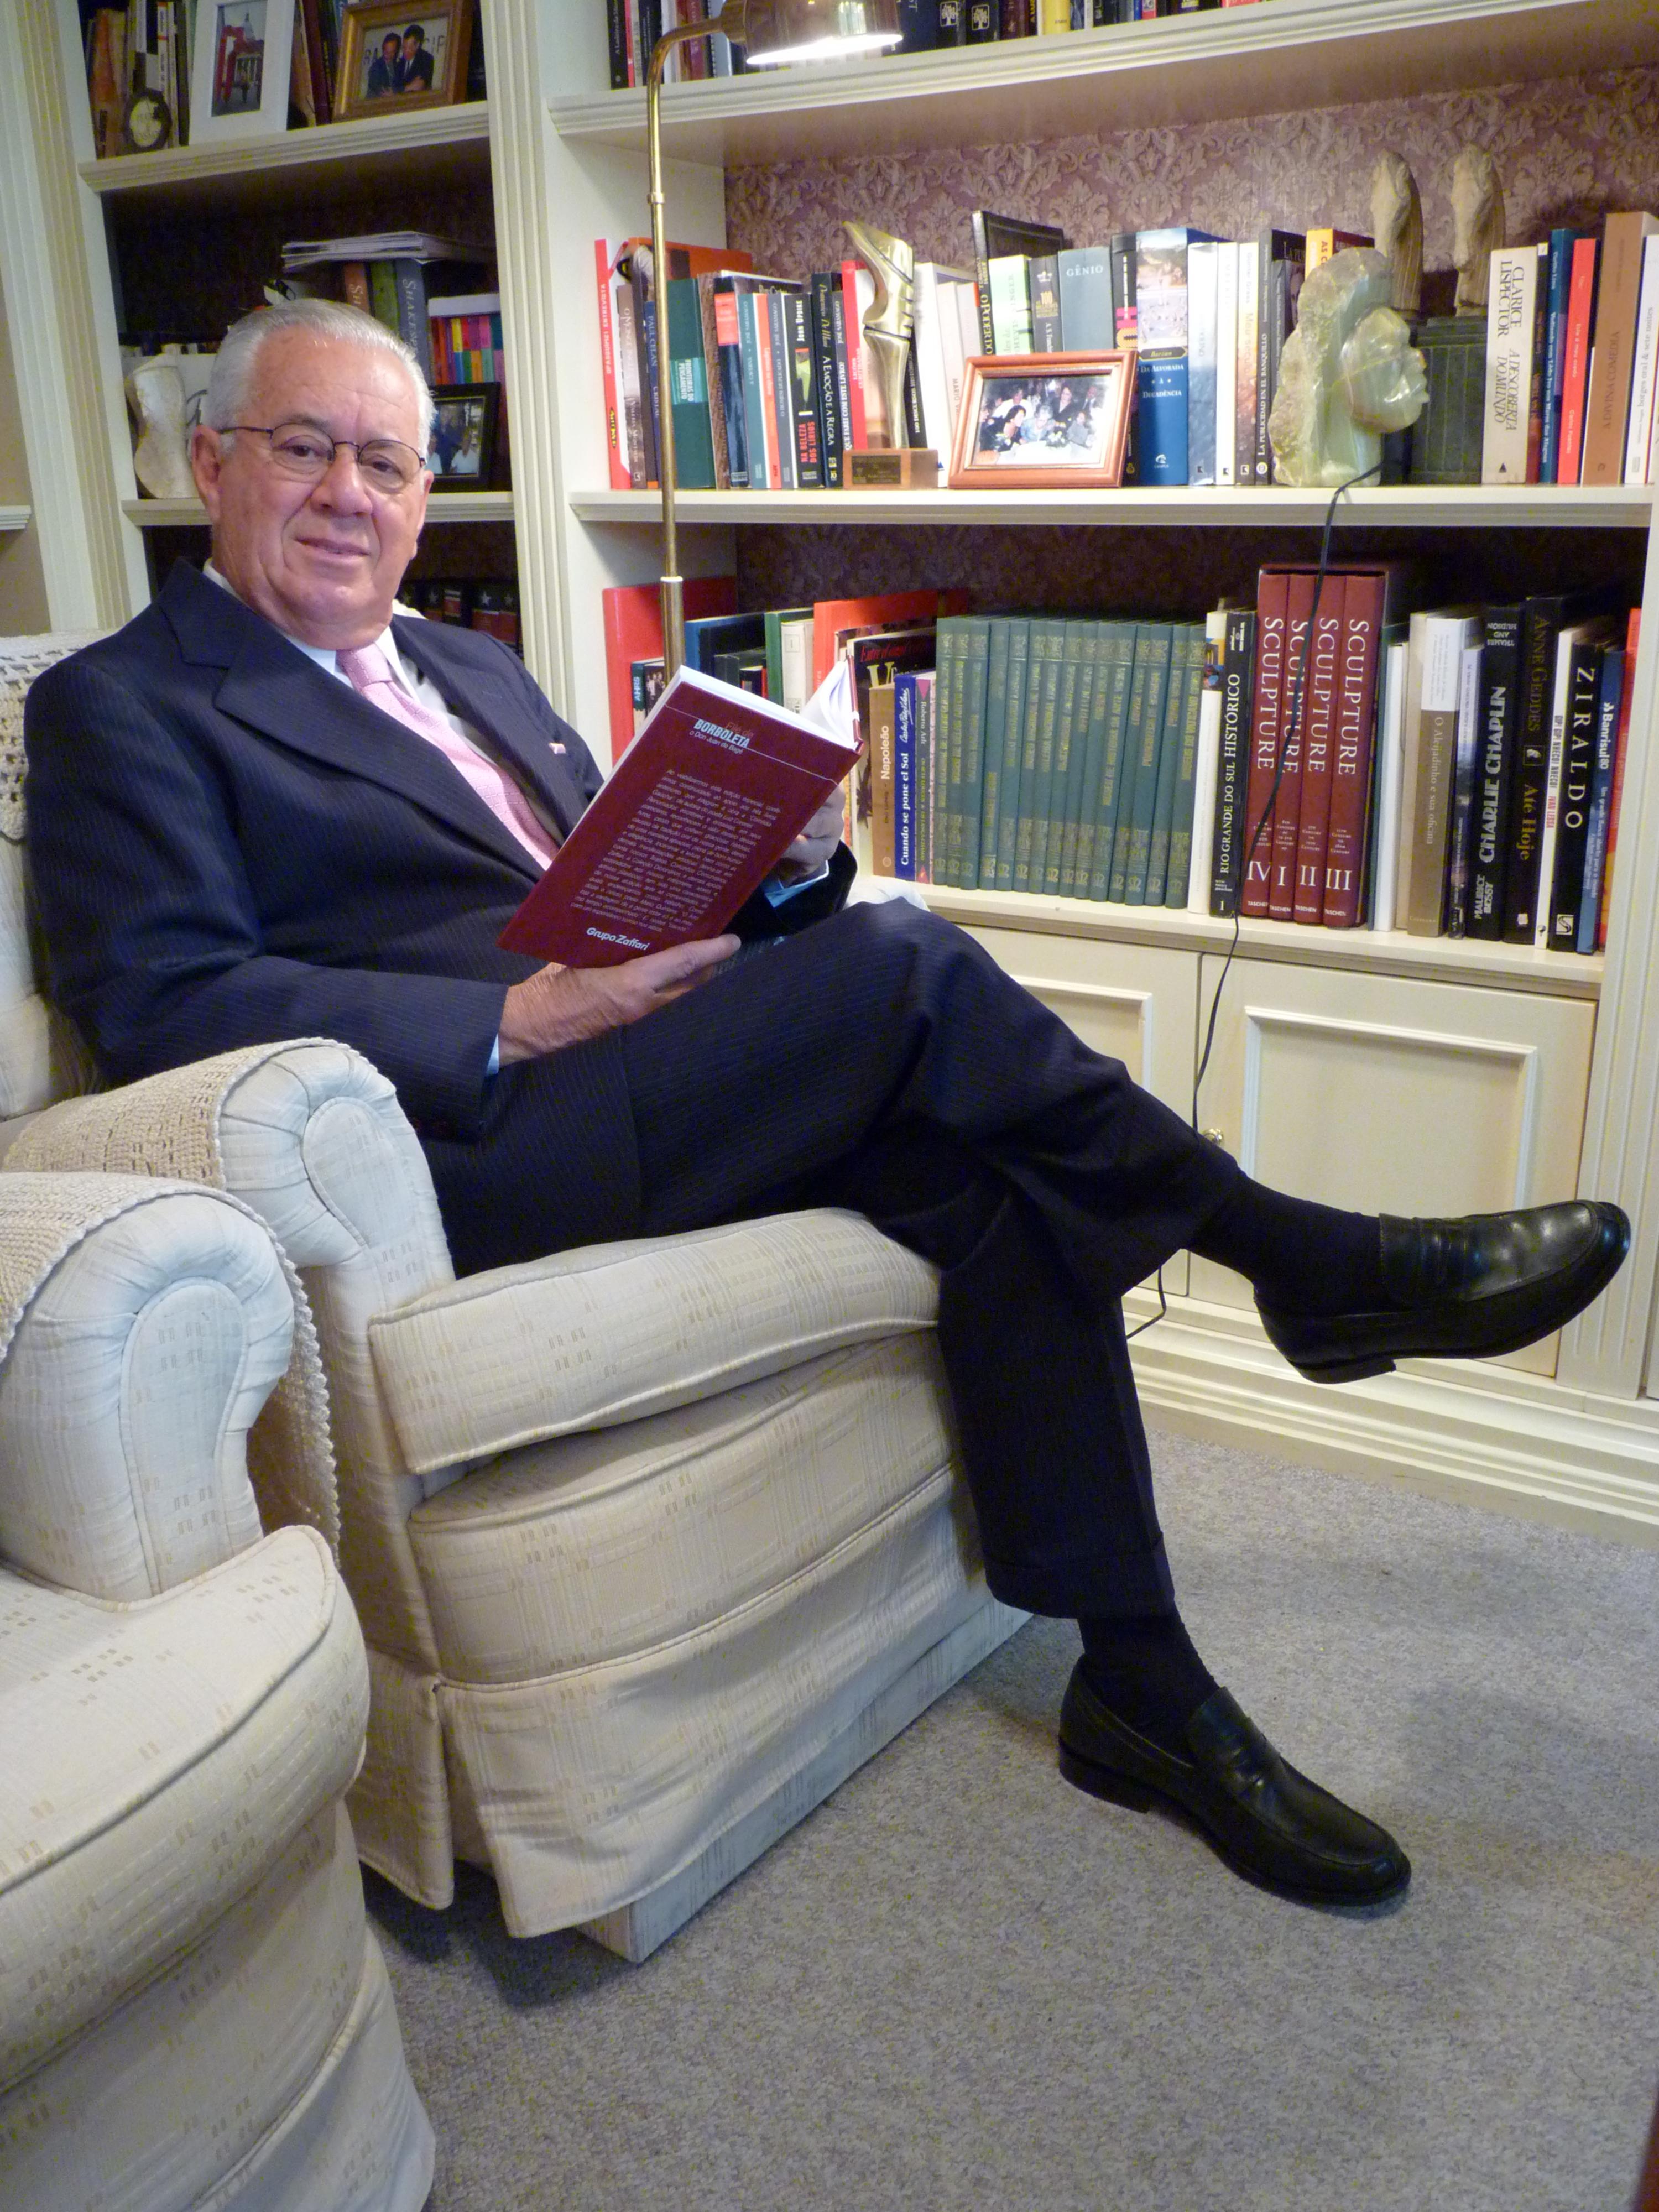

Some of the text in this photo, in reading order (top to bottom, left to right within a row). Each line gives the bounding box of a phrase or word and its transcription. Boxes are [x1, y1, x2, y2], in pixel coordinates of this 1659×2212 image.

[1066, 264, 1104, 277] GÊNIO
[600, 283, 609, 328] ENTREVISTA
[1497, 260, 1512, 337] LISPECTOR
[1510, 266, 1524, 328] CLARICE
[795, 299, 805, 342] JOHN UPDIKE
[1245, 312, 1254, 336] Meu
[648, 315, 659, 367] PAUL CELAN
[822, 356, 832, 364] A
[1151, 363, 1185, 372] ALVORADA
[678, 362, 687, 400] PENSAMENTO
[685, 358, 695, 402] FRONTEIRAS DO
[822, 364, 834, 403] EMOÇÃO
[952, 378, 960, 401] MARIO
[1142, 389, 1182, 398] DECADÊNCIA
[1260, 379, 1267, 388] EL
[1260, 389, 1266, 399] EN
[1494, 356, 1508, 424] DO MUNDO
[1506, 348, 1520, 431] A DESCOBERTA
[1637, 379, 1647, 407] borges
[1603, 383, 1615, 421] DIVINA
[798, 424, 808, 463] NA BELEZA
[826, 416, 835, 446] REGRA
[844, 435, 853, 451] QUE
[808, 448, 817, 463] DOS
[1487, 638, 1515, 647] THAMES
[1528, 615, 1550, 732] ANNE GEDDES
[1257, 617, 1284, 769] SCULPTURE
[1308, 617, 1339, 772] SCULPTURE
[1338, 619, 1369, 775] SCULPTURE
[1224, 673, 1240, 758] HISTÓRICO
[1434, 717, 1444, 726] O
[693, 719, 750, 748] BORBOLETA
[695, 731, 707, 740] Don
[1564, 666, 1596, 828] ZIRALDO
[1599, 713, 1614, 758] Banrisul
[880, 725, 890, 780] Napoleão
[1431, 729, 1443, 783] Aleijadinho
[1225, 762, 1237, 782] SUL
[1479, 686, 1506, 863] CHARLIE CHAPLIN
[900, 753, 911, 866] Cuando se pone el Sol
[1224, 785, 1234, 803] DO
[1548, 795, 1557, 810] IVAN
[1221, 805, 1233, 852] GRANDE
[1426, 813, 1437, 845] oficina
[1516, 784, 1539, 861] Até Hoje
[1546, 811, 1556, 829] LESSA
[1220, 853, 1230, 874] RIO
[1246, 860, 1271, 881] IV
[1277, 866, 1287, 886] I
[1300, 865, 1318, 887] II
[1325, 868, 1353, 891] III
[1270, 904, 1291, 912] TASCHEN
[1295, 904, 1317, 913] TASCHEN
[1474, 874, 1485, 920] MAURICE
[1483, 881, 1494, 914] BESSY
[586, 927, 650, 951] Grupo Zaffari
